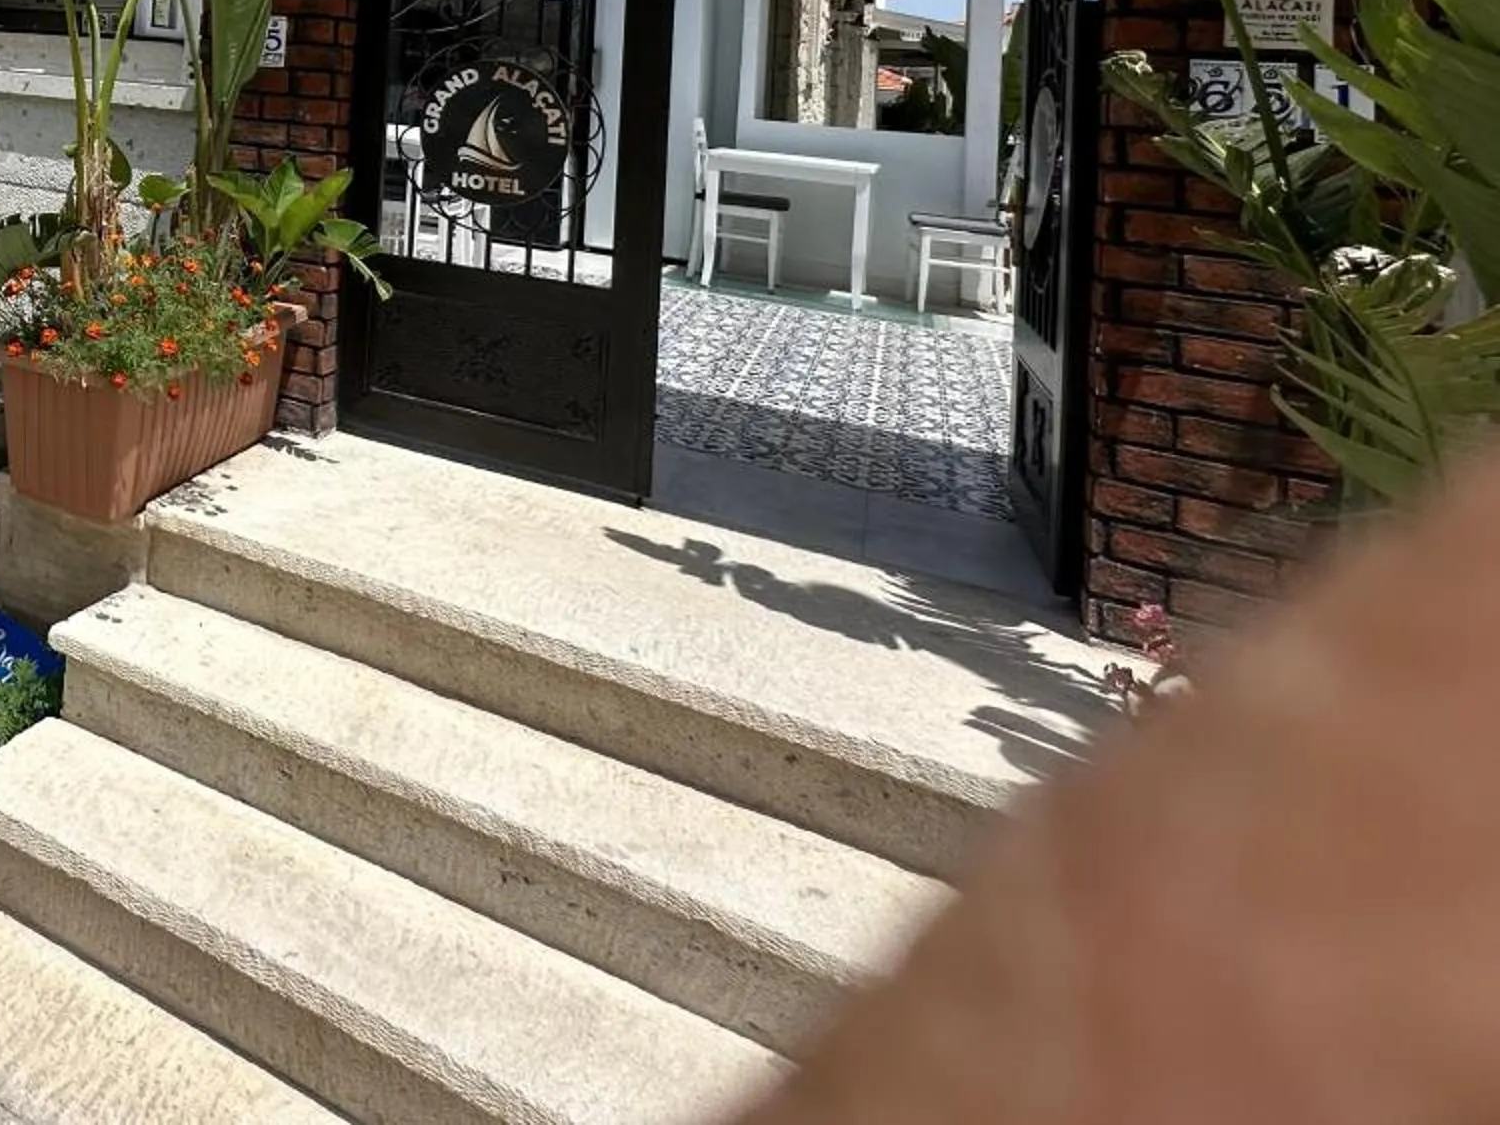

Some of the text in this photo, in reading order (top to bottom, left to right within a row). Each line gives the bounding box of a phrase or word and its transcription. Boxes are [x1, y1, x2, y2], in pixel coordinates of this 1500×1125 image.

[423, 65, 567, 146] GRAND ALAÇATI
[451, 171, 526, 196] HOTEL
